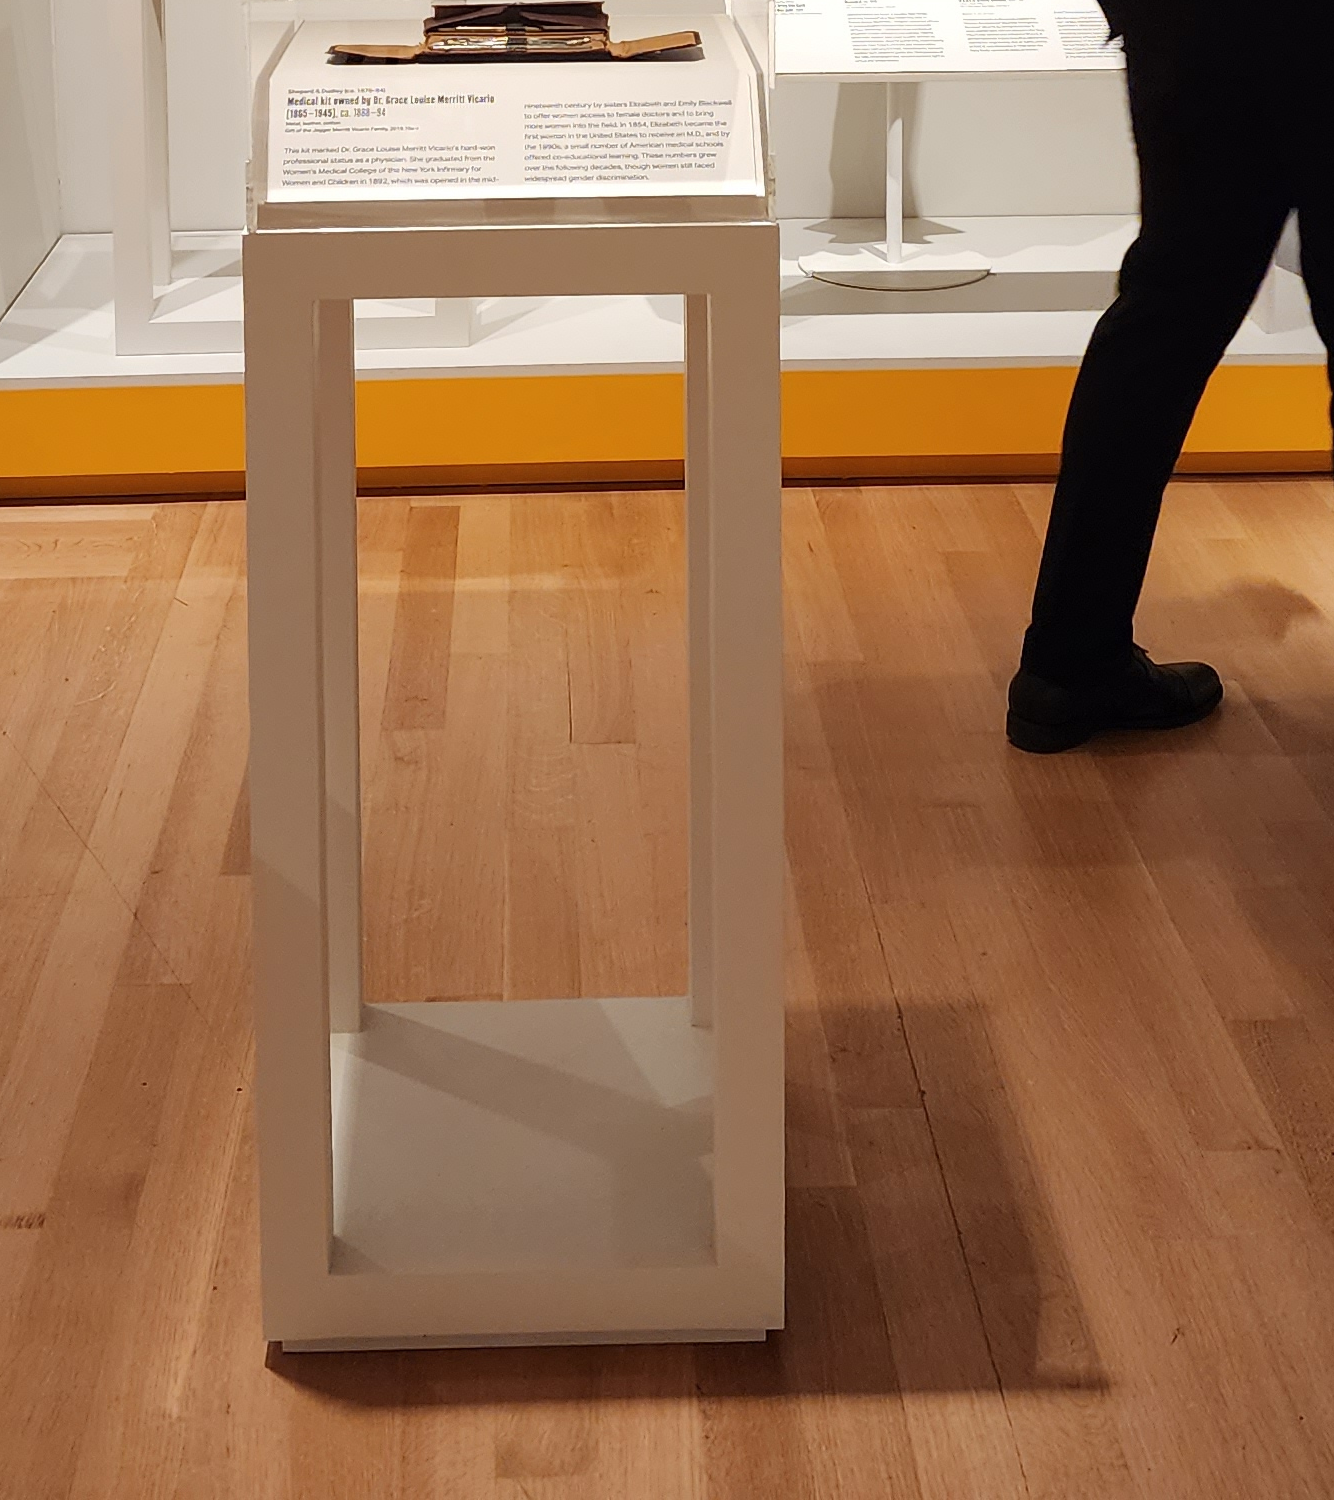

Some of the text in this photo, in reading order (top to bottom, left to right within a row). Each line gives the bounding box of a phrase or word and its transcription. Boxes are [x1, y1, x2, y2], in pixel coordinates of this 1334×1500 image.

[288, 94, 495, 106] Medical kit owned by Dr. Grace Louise Merritt Vicario
[426, 156, 463, 164] graduated
